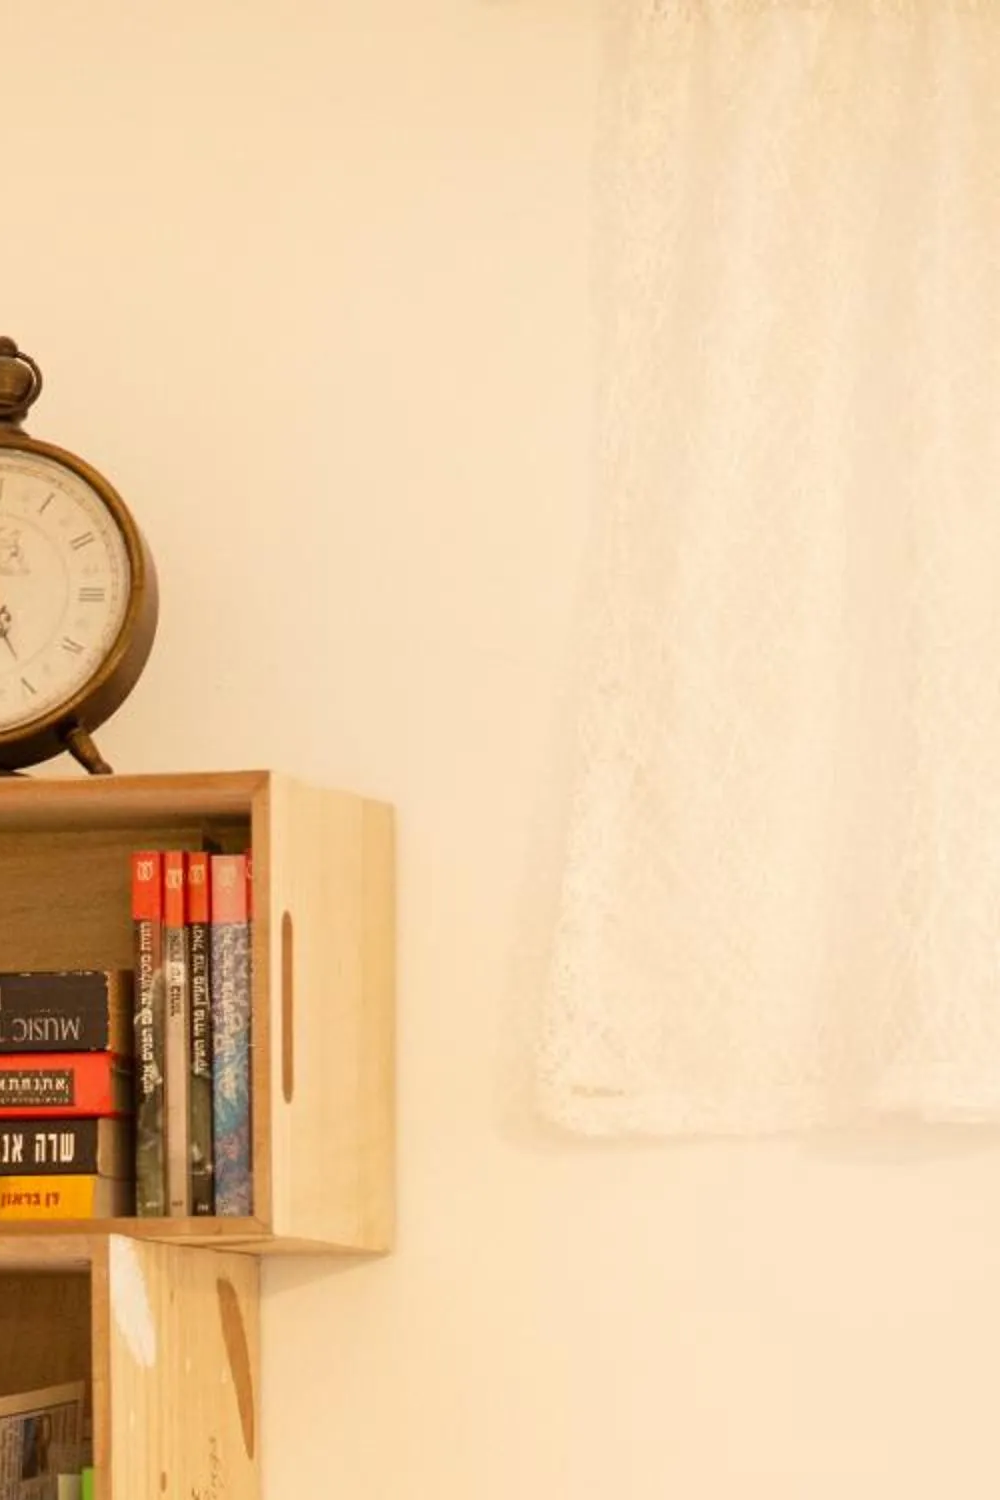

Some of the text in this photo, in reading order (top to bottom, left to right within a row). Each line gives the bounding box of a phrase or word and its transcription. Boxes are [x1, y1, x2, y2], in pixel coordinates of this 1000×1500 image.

[13, 1017, 80, 1041] MUSIC
[35, 1130, 76, 1164] שרה
[1, 1192, 61, 1208] דן בראון
